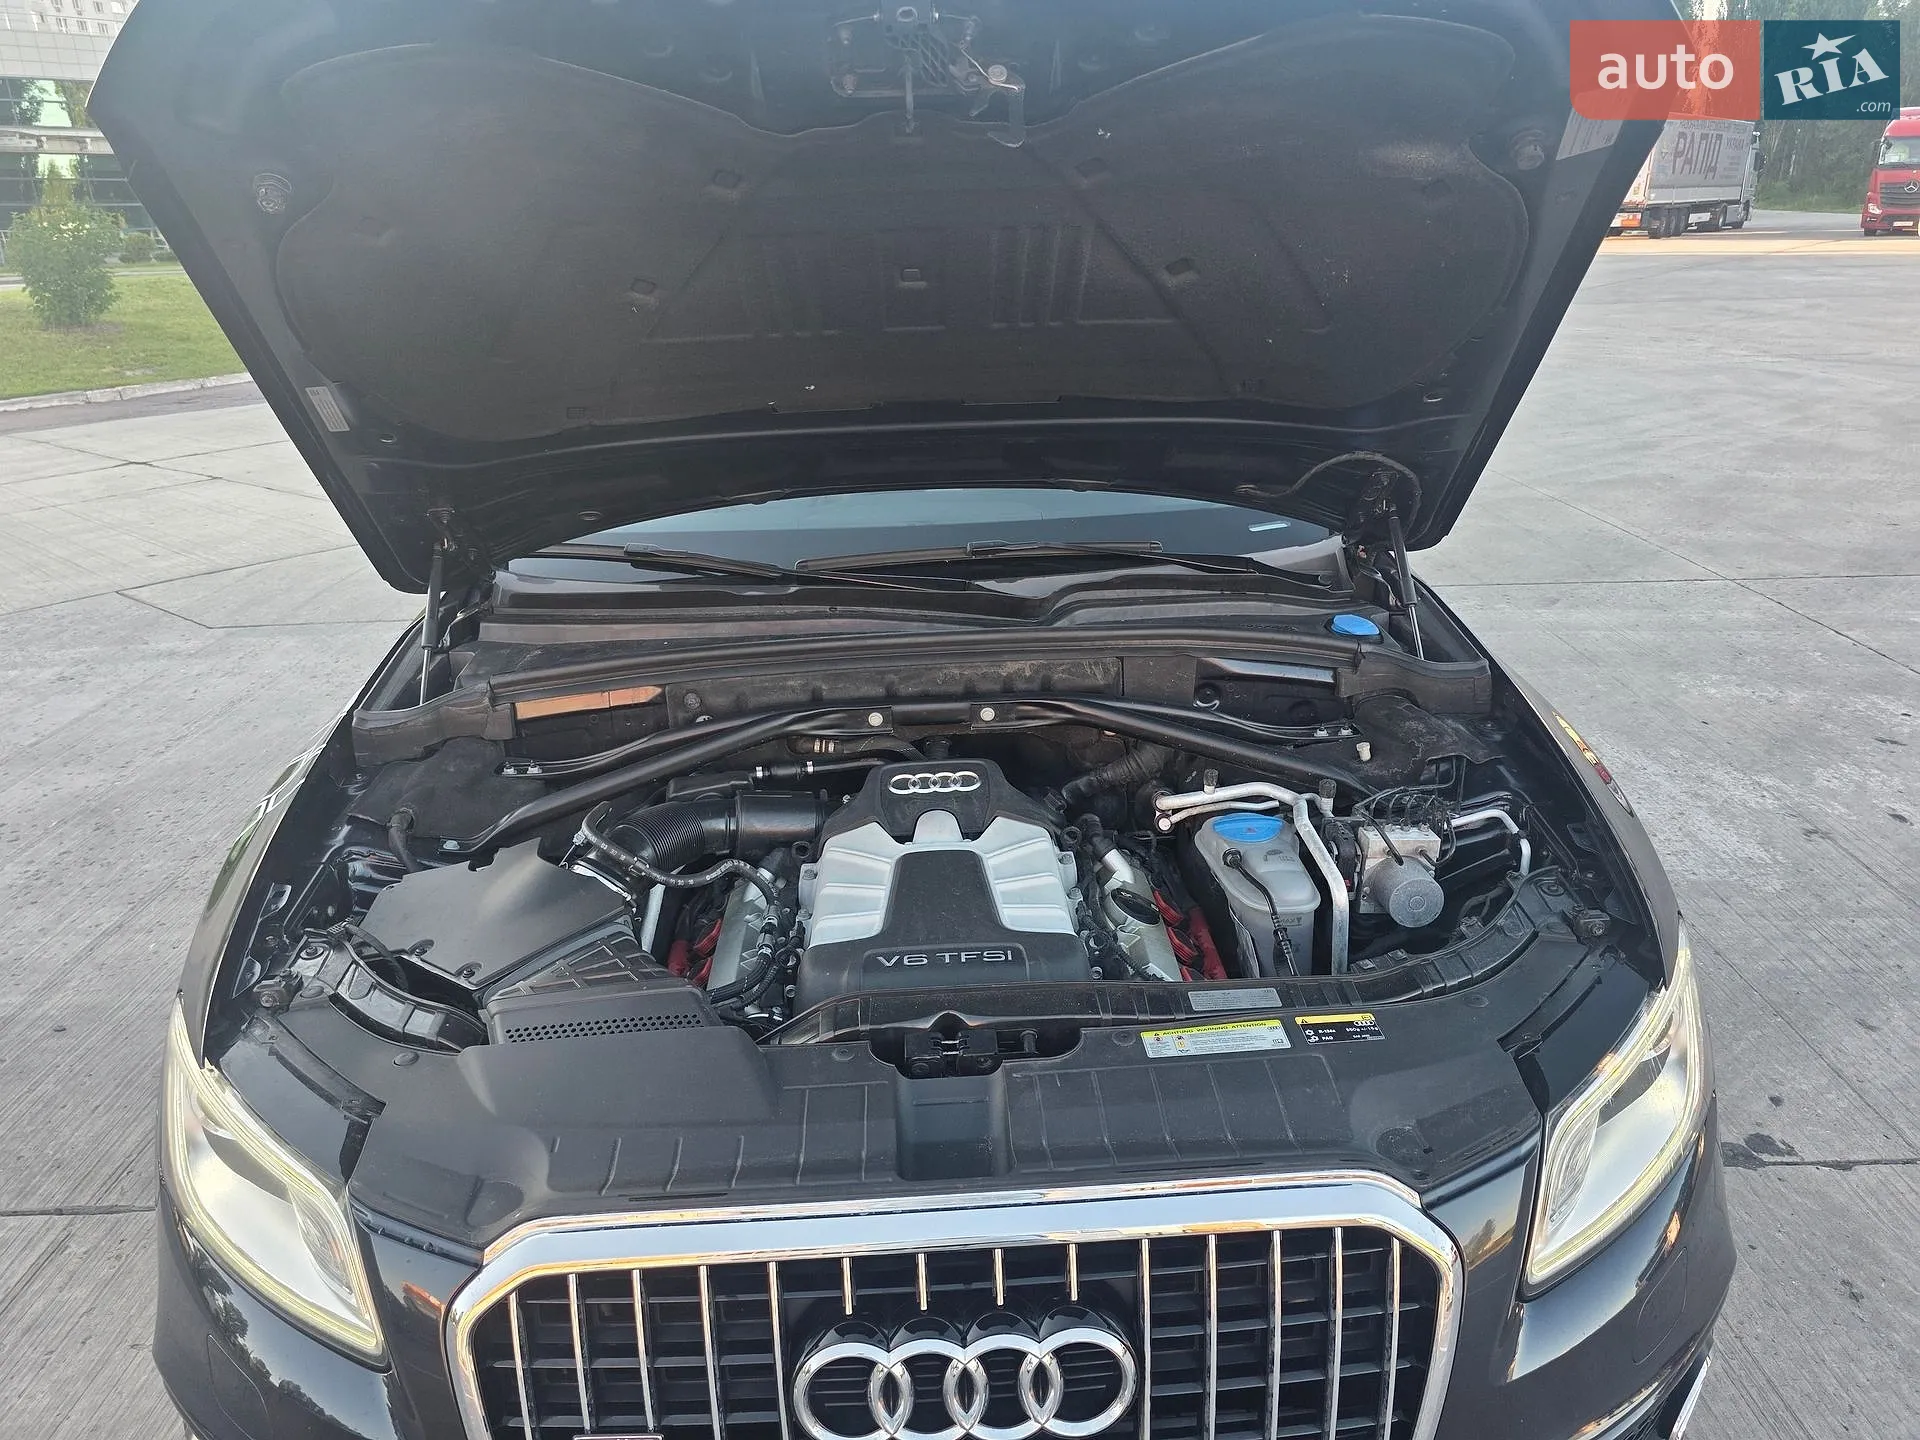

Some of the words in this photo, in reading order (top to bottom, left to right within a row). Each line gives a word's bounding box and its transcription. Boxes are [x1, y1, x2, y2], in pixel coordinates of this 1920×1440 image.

[876, 953, 928, 967] V6
[935, 950, 1012, 964] TFSI
[1162, 1028, 1194, 1036] ACHTUNG
[1196, 1025, 1229, 1033] WARNING
[1231, 1022, 1267, 1030] ATTENTION
